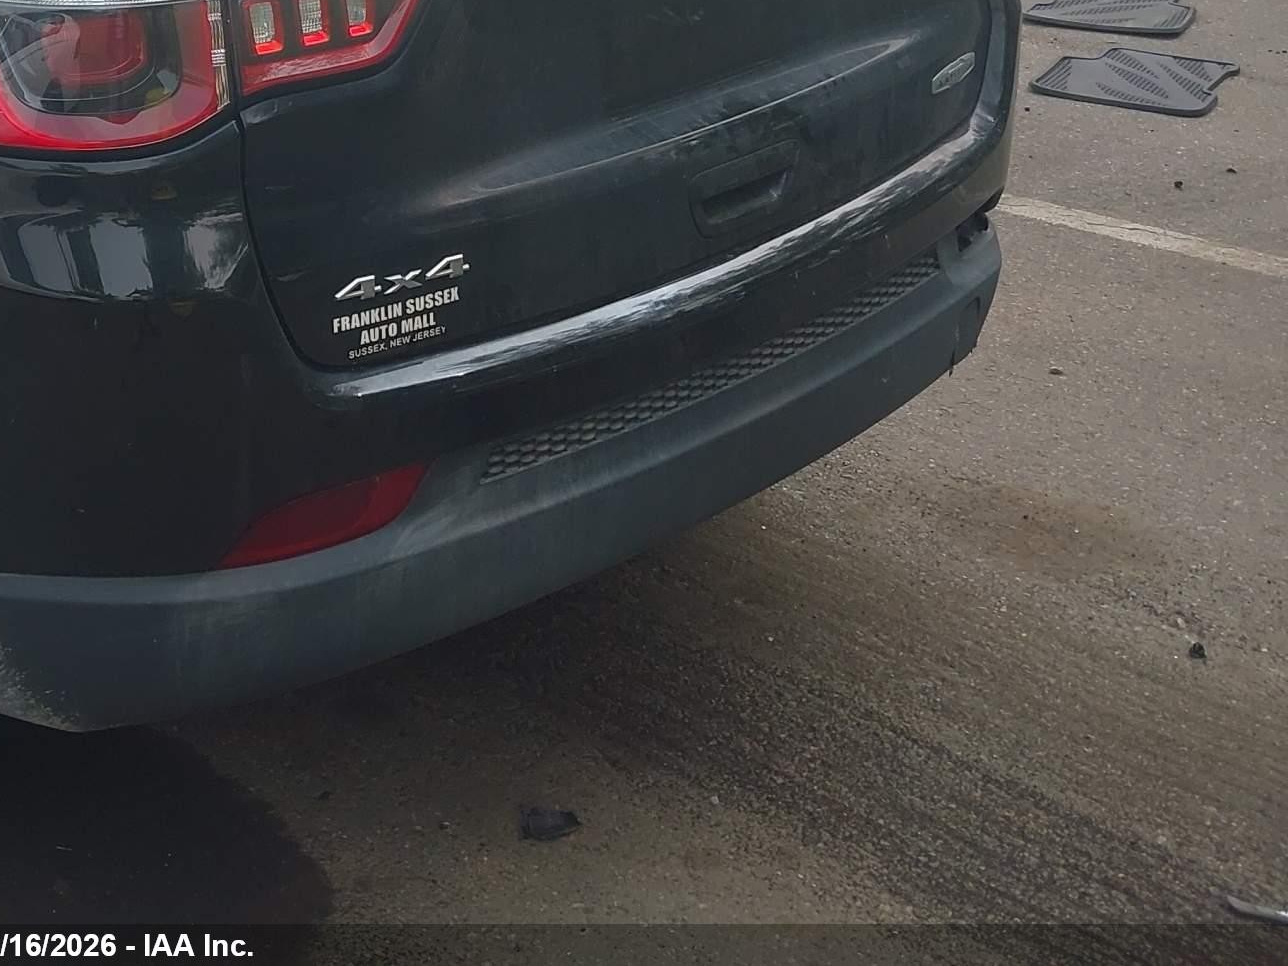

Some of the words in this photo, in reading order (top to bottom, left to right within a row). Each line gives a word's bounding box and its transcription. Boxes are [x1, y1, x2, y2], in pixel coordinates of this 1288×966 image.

[332, 302, 403, 333] FRANKLIN
[405, 285, 460, 316] SUSSEX
[348, 341, 388, 360] SUSSEX,
[389, 334, 412, 349] NEW
[412, 325, 447, 343] JERSEY
[360, 323, 399, 345] AUTO
[401, 311, 437, 335] MALL
